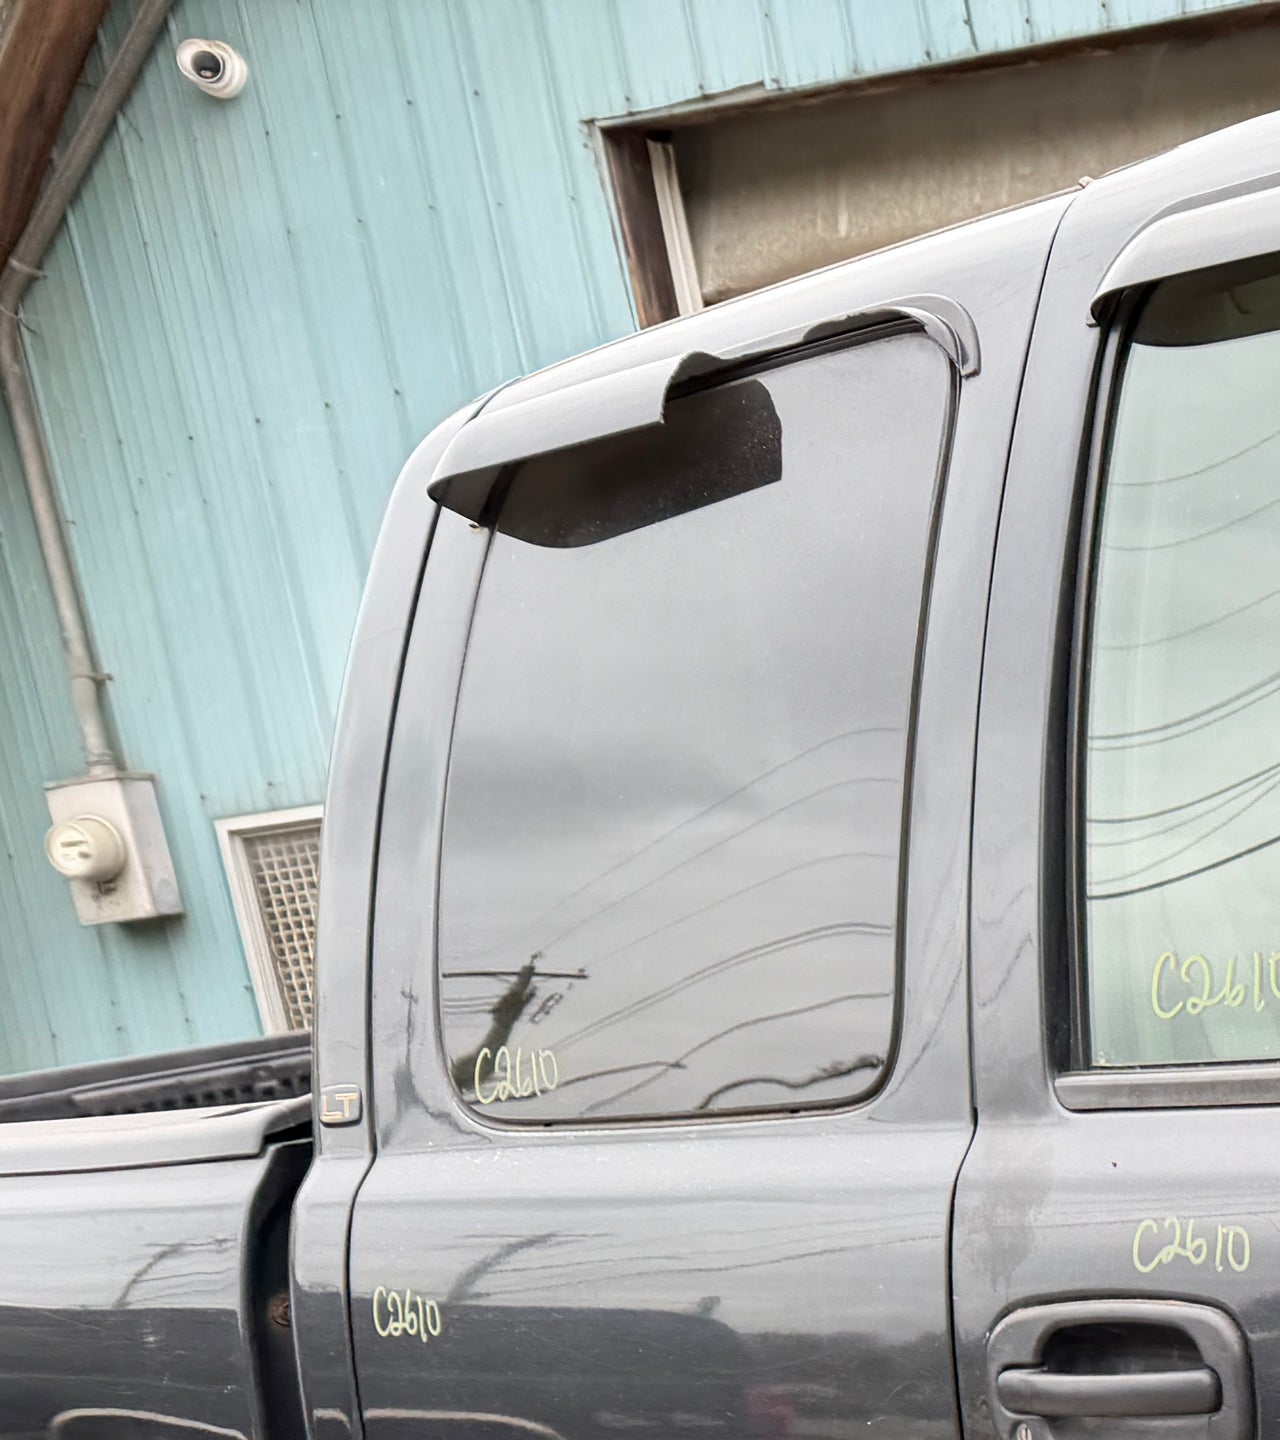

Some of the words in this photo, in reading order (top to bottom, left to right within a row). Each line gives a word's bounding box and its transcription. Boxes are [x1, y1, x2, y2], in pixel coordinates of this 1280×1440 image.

[474, 1046, 559, 1104] C2610
[321, 1092, 357, 1121] LT
[372, 1286, 442, 1343] C2610
